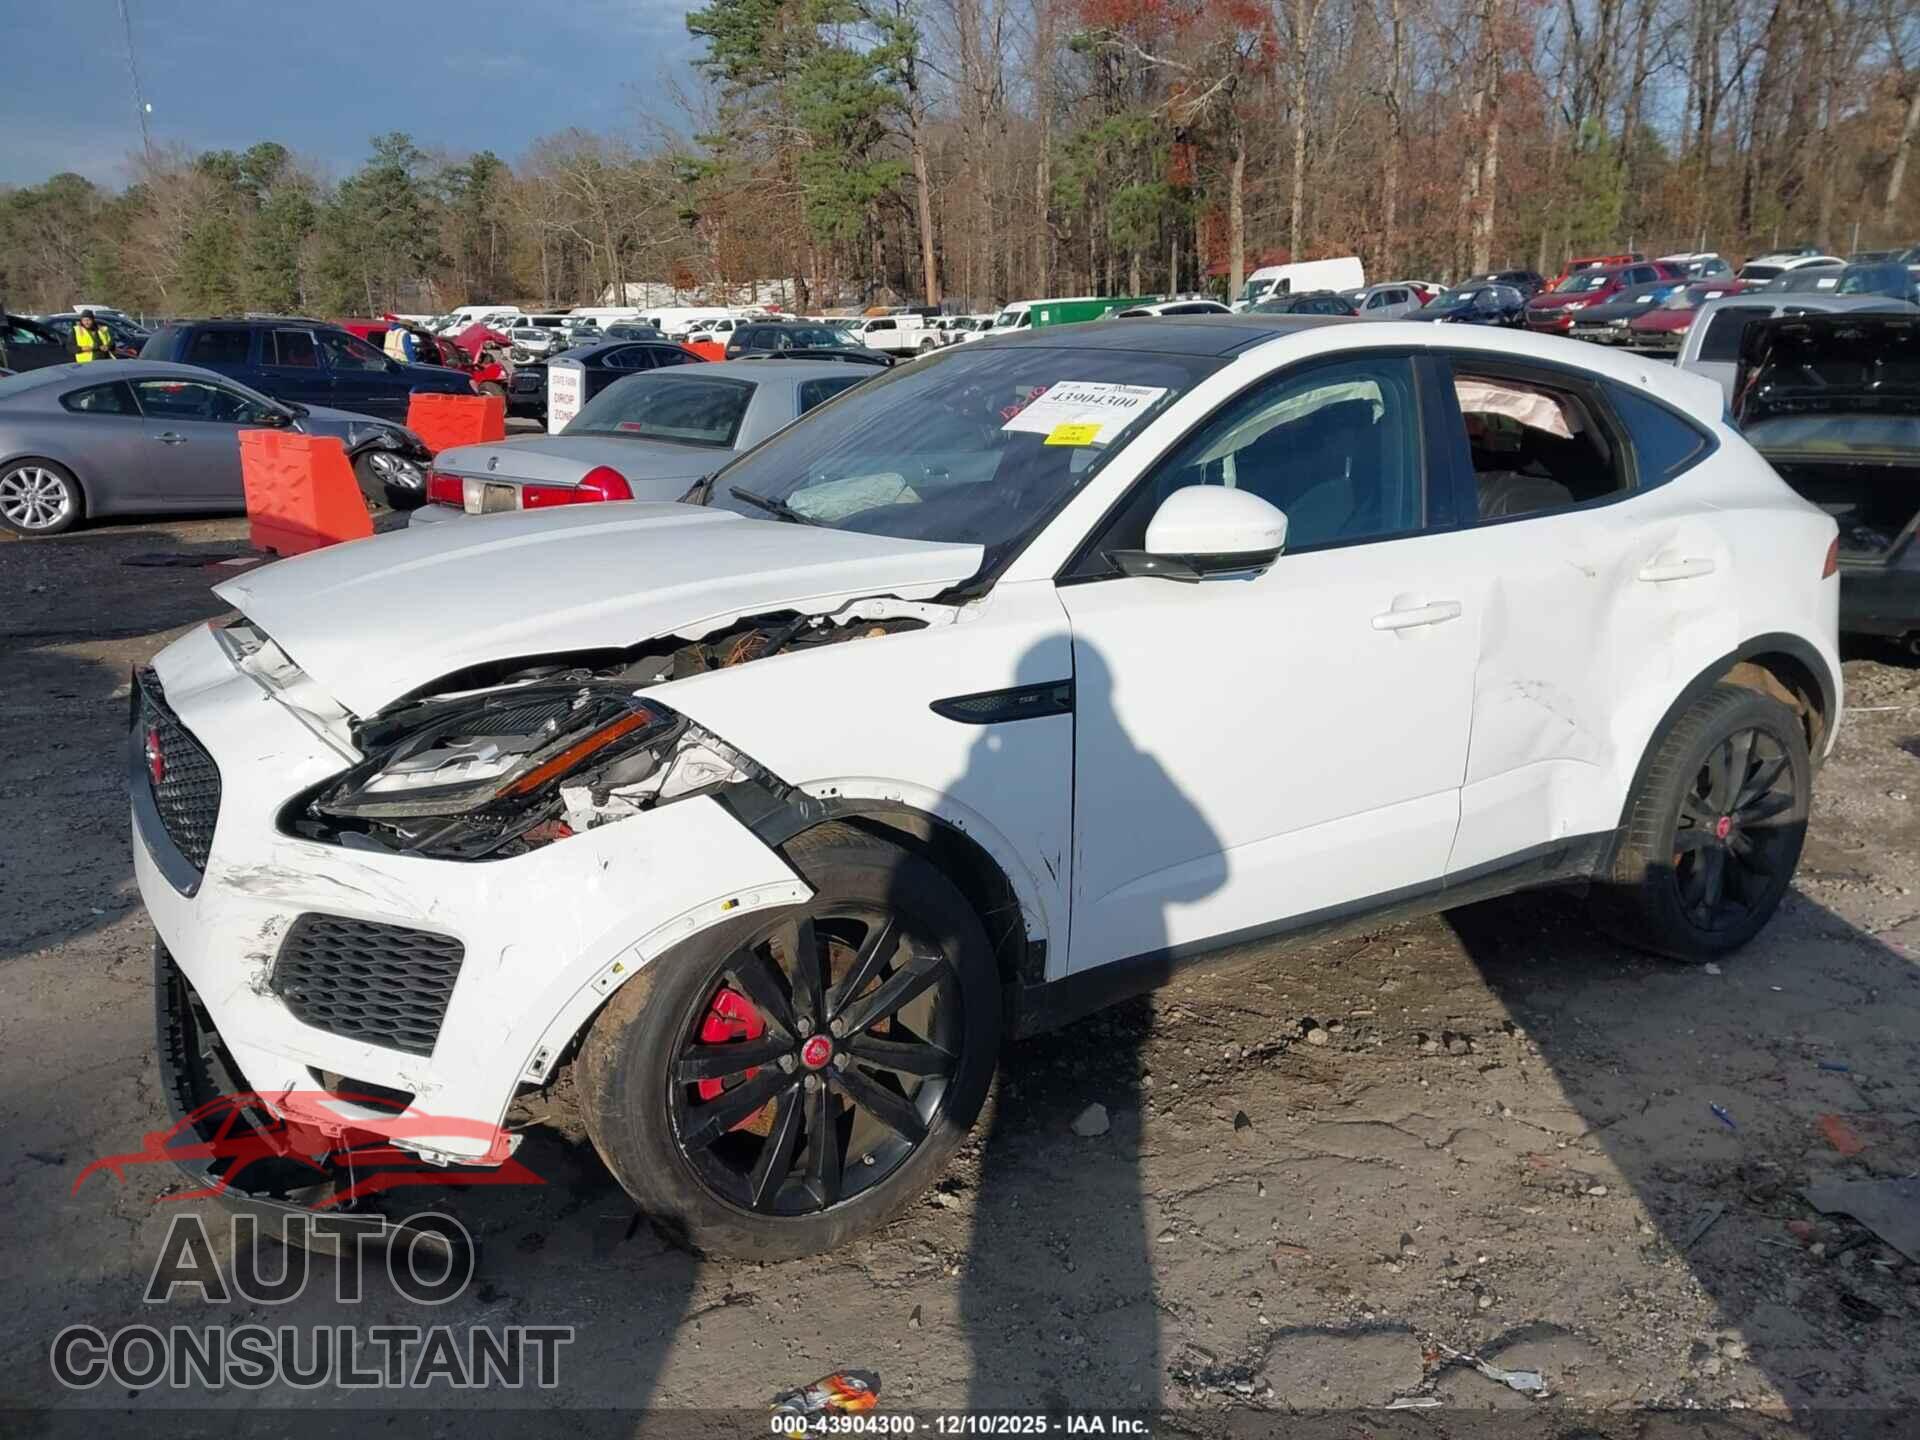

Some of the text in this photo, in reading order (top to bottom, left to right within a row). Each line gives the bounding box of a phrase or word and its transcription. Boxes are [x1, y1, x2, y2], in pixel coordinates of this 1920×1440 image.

[554, 392, 575, 405] DROP
[1051, 391, 1139, 408] 43904300
[554, 408, 575, 420] ZONE
